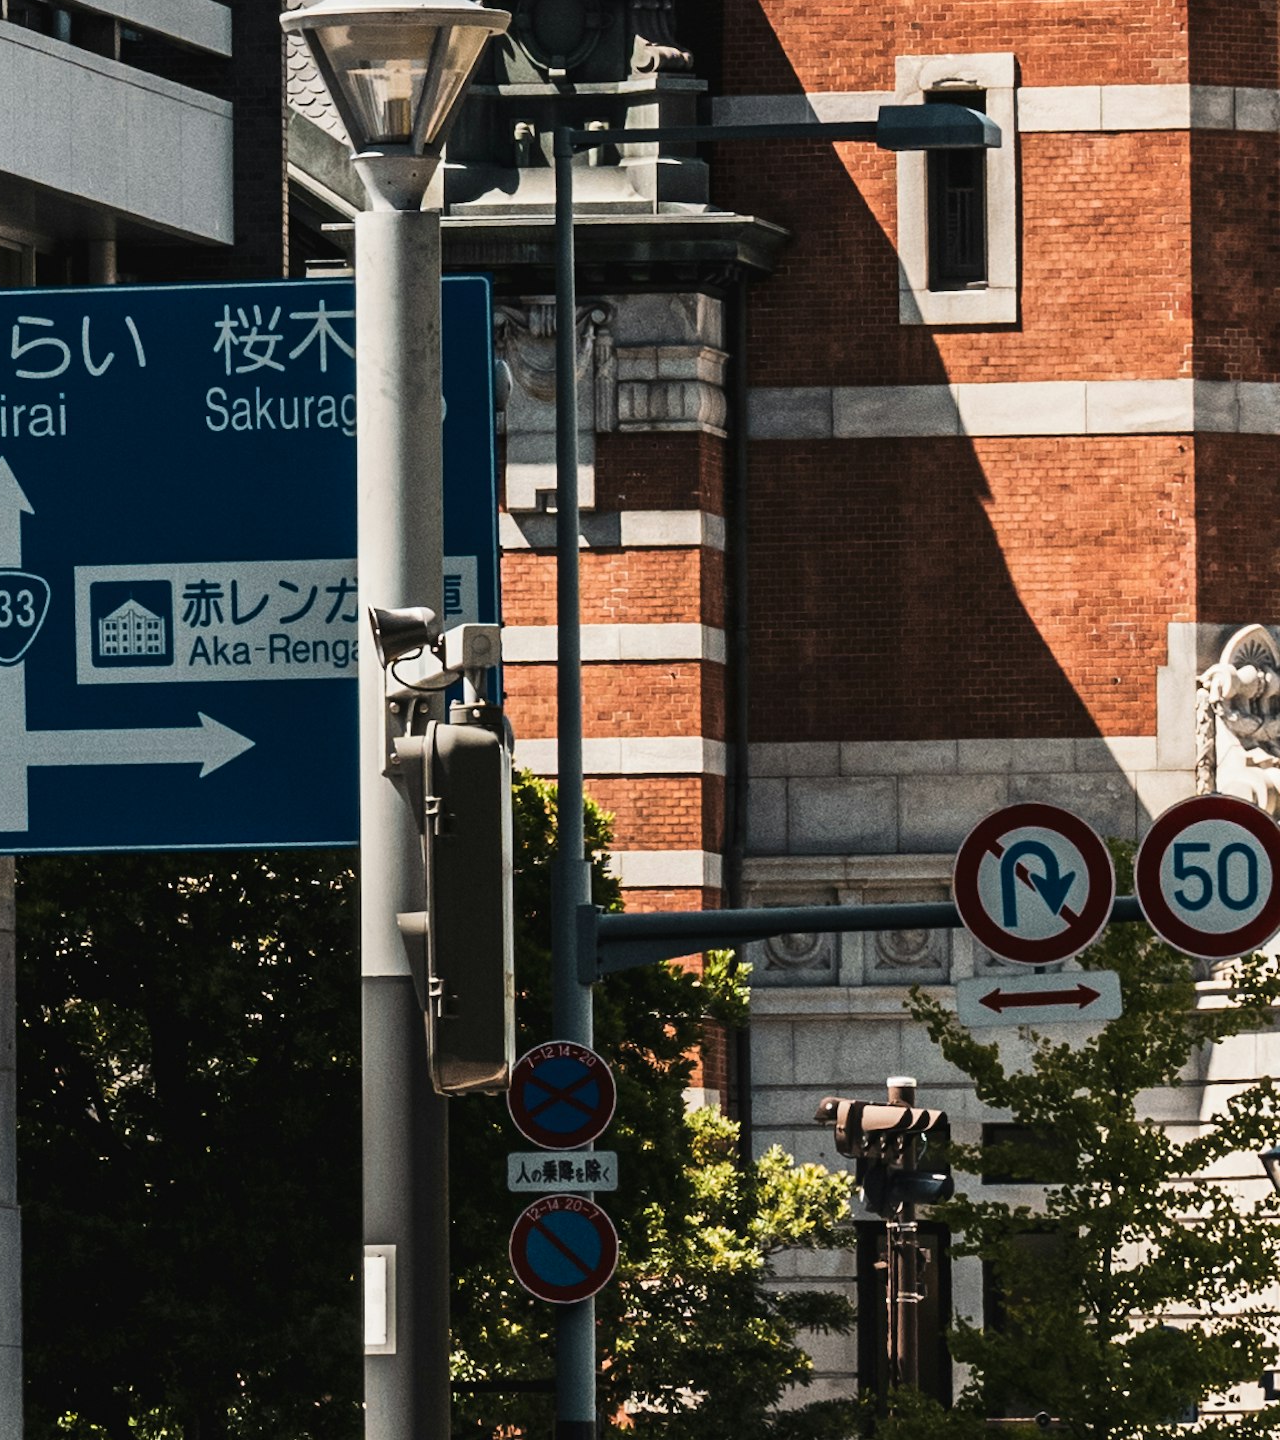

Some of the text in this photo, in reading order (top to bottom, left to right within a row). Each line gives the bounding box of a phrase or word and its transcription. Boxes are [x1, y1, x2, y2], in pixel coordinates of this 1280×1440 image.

[213, 299, 356, 376] 桜木
[1173, 842, 1259, 911] 50
[515, 1159, 610, 1184] 人の乗降を除く
